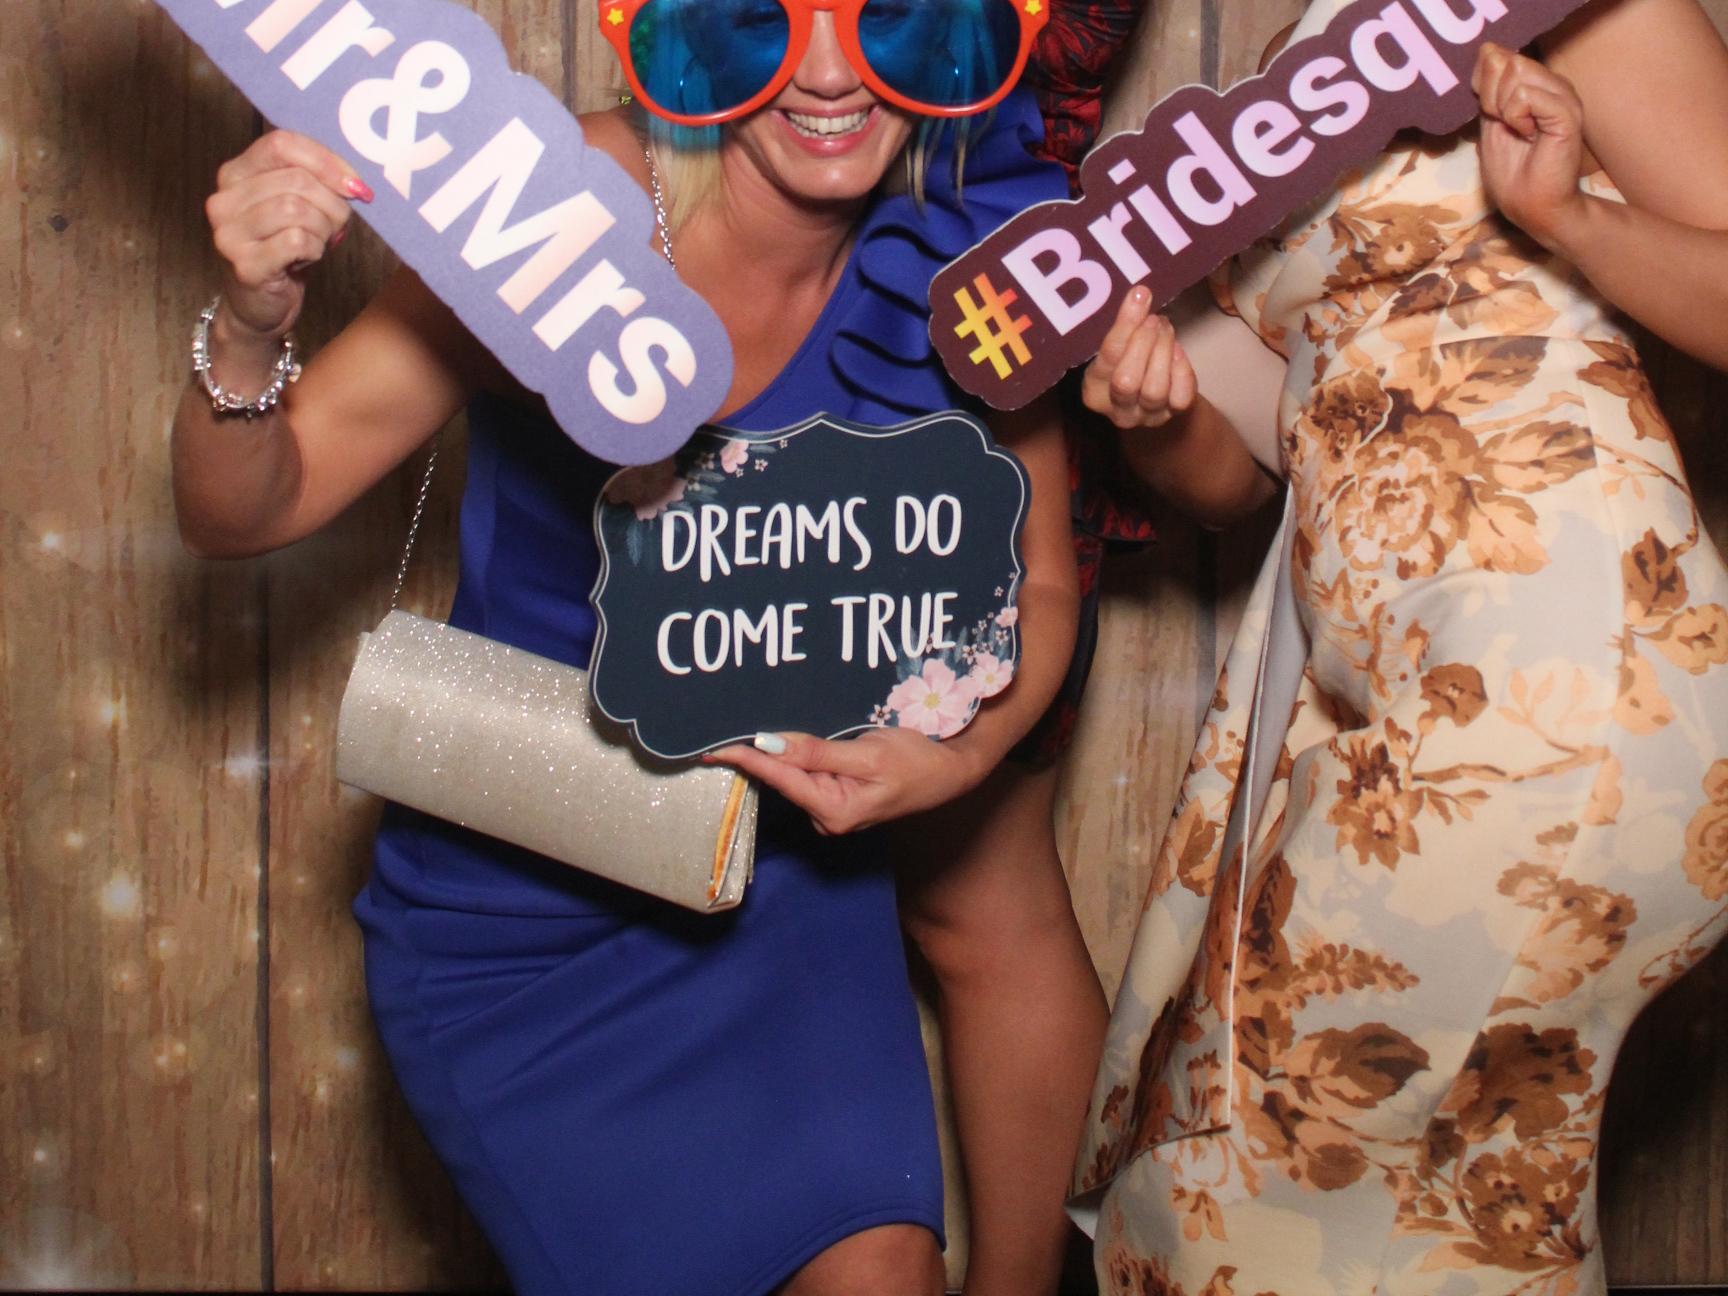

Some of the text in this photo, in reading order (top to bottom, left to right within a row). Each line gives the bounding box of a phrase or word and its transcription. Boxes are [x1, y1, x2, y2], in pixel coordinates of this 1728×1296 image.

[661, 494, 963, 582] DREAMS DO
[657, 592, 960, 675] COME TRUE
